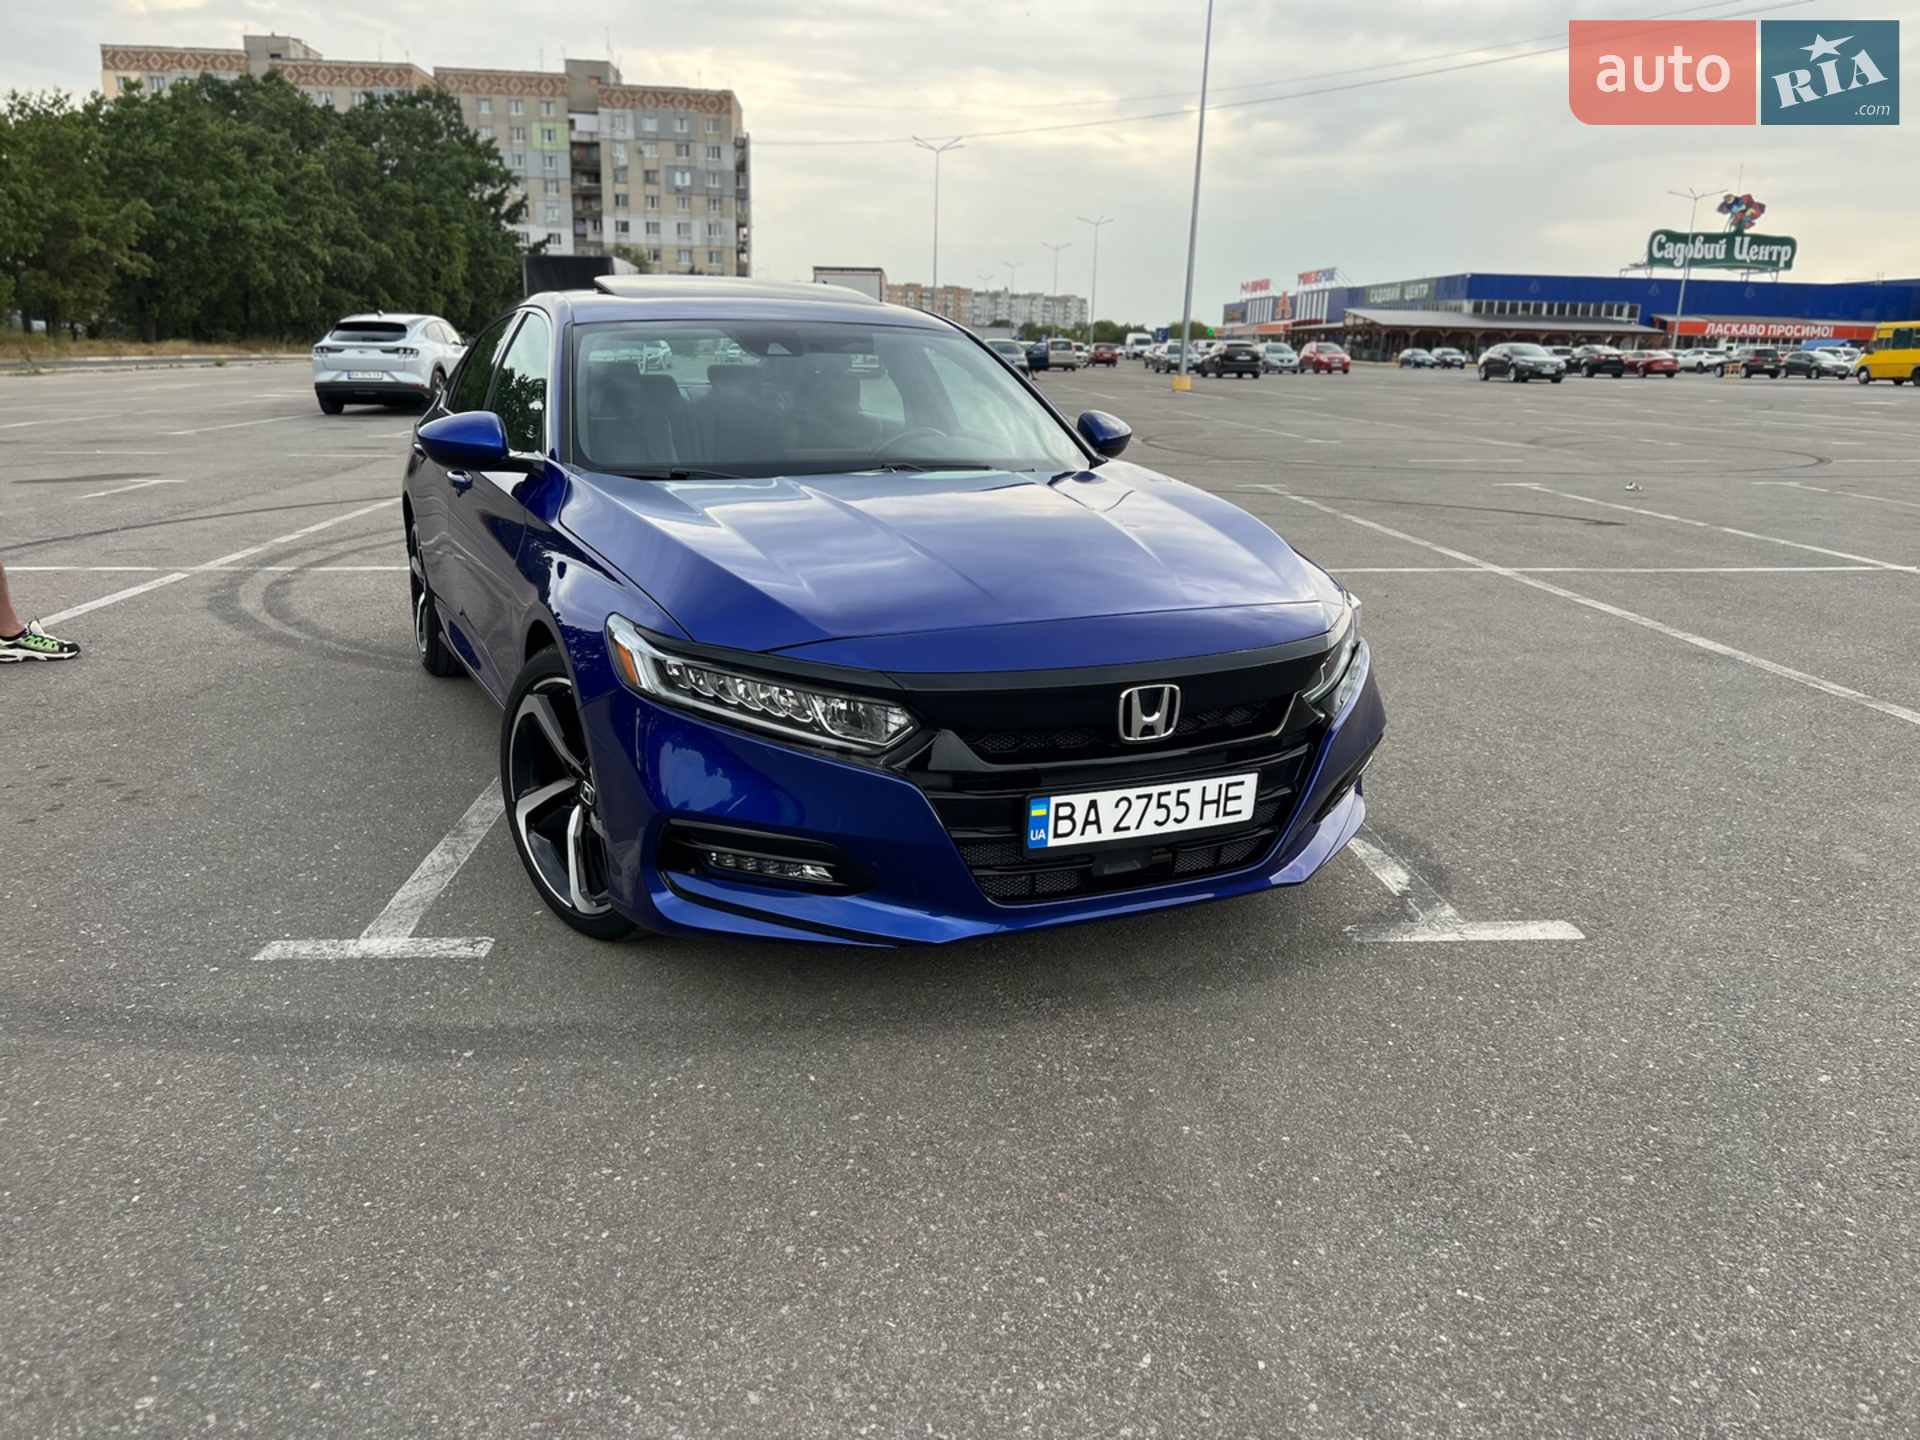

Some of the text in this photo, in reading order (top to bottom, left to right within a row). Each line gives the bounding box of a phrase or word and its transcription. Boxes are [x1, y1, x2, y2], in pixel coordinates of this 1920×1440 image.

[1652, 234, 1792, 268] Садовий Центр
[1704, 322, 1835, 338] ЛАСКАВО ПРОСИМО!
[1052, 780, 1245, 839] BA 2755 HE
[1030, 829, 1046, 841] UA
